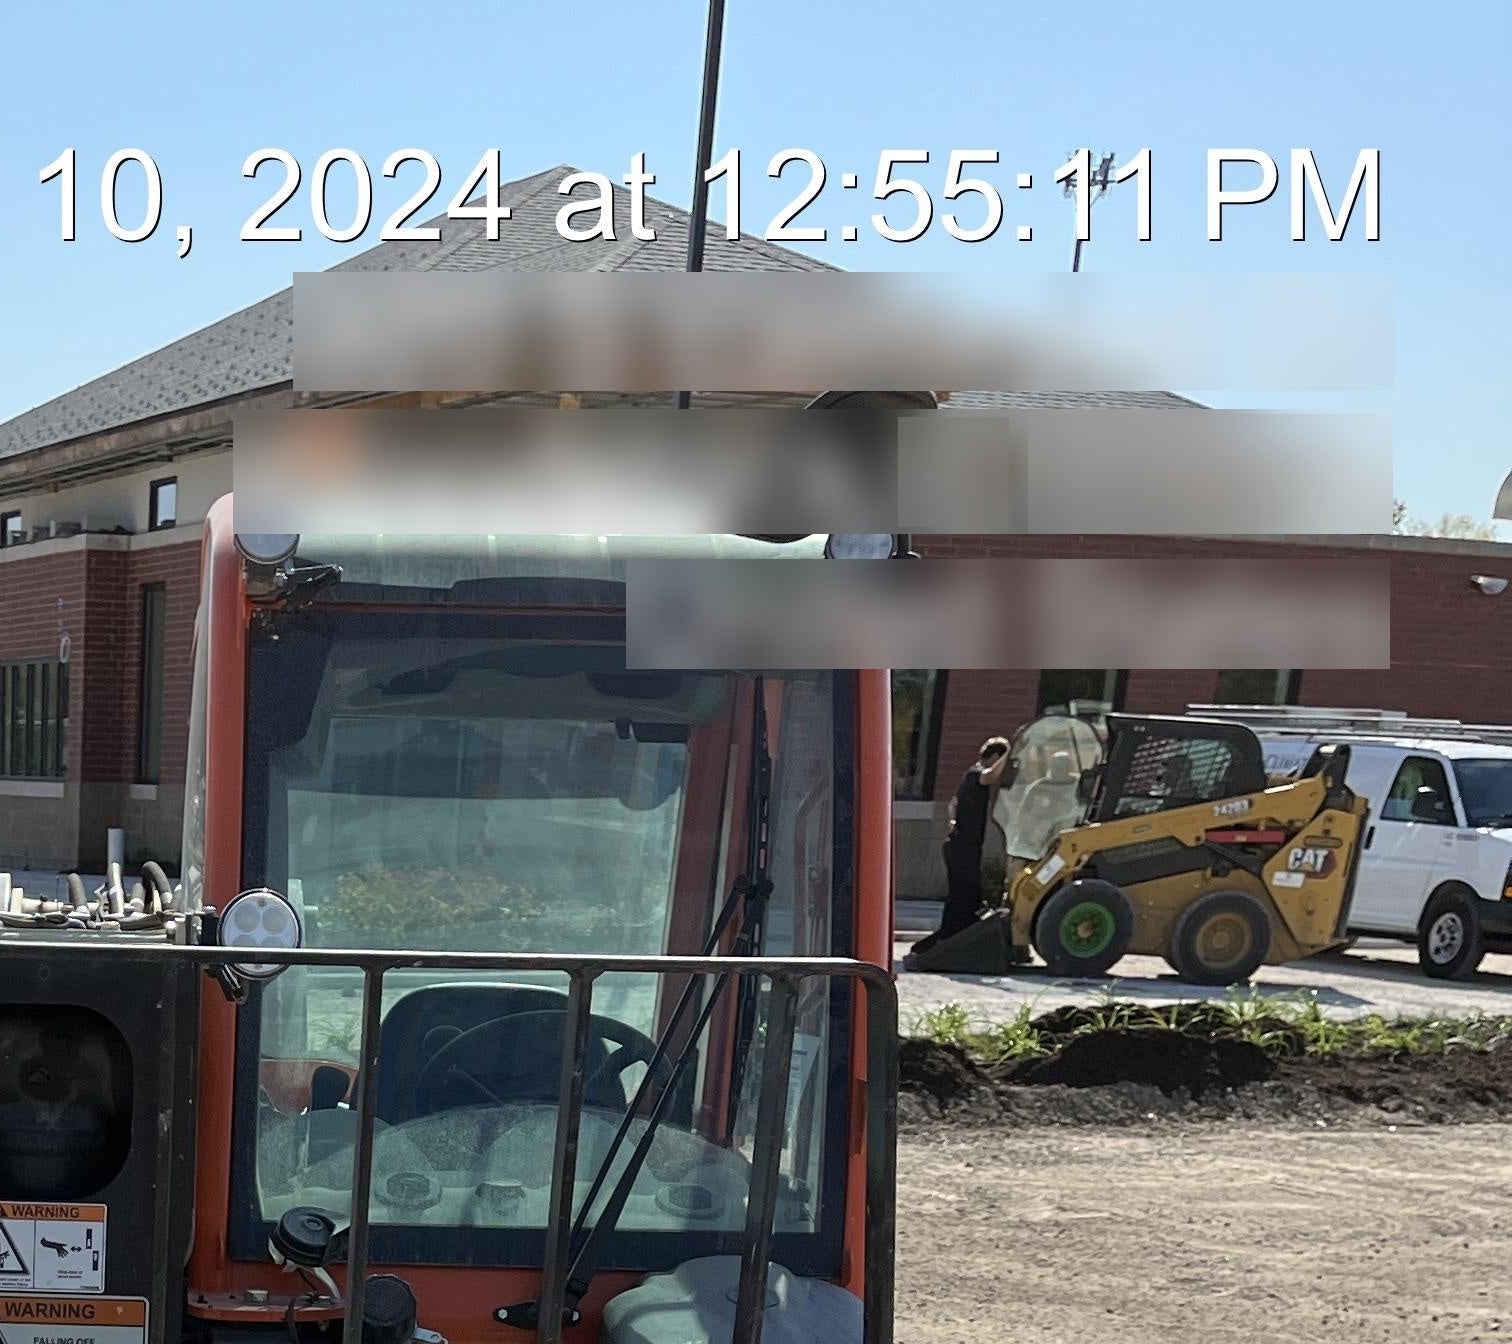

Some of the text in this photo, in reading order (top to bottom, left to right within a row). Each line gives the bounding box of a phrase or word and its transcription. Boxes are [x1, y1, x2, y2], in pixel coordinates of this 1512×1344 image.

[1288, 847, 1329, 873] CAT
[11, 1204, 80, 1218] WARNING
[5, 1301, 96, 1319] WARNING
